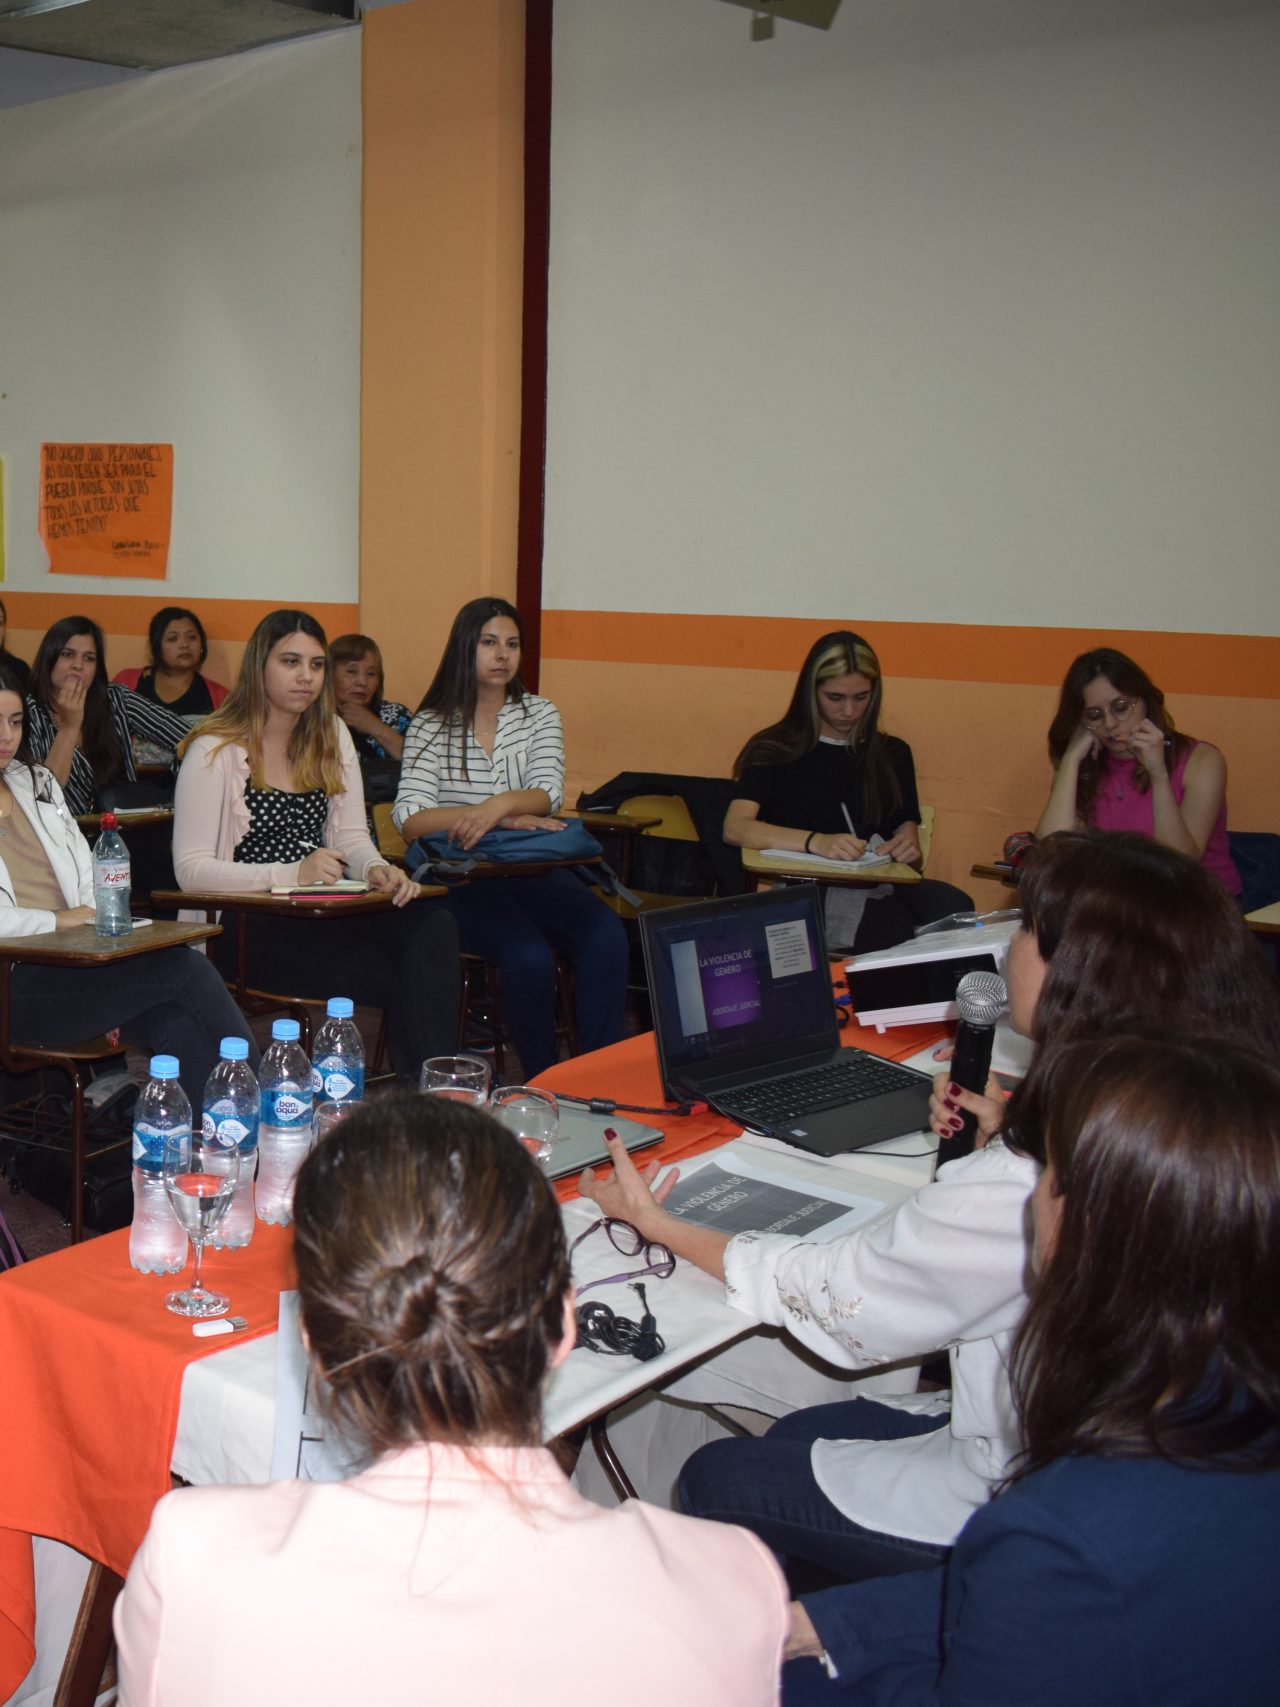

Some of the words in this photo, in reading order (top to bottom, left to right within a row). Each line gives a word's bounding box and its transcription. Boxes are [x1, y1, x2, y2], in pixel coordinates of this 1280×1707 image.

[143, 462, 157, 477] EL
[45, 480, 76, 500] PUEBLO
[123, 495, 141, 513] QUE
[699, 958, 709, 968] LA
[708, 951, 743, 966] VIOLENCIA
[742, 949, 753, 959] DE
[275, 1107, 298, 1115] aqua
[680, 1183, 734, 1208] VIOLENCIA
[726, 1176, 748, 1186] DE
